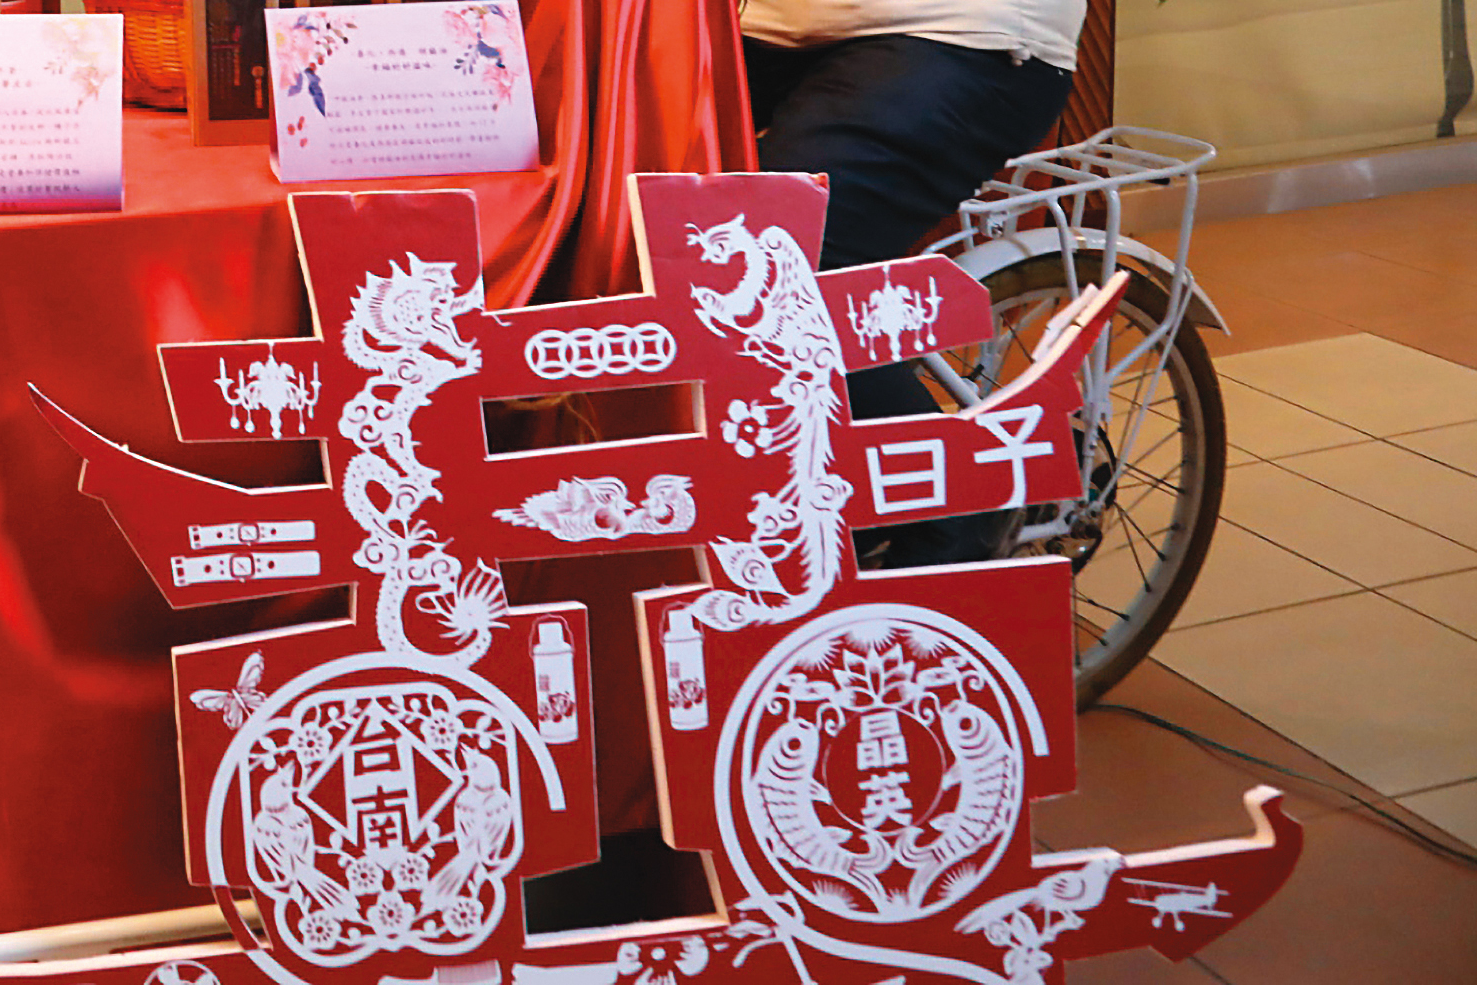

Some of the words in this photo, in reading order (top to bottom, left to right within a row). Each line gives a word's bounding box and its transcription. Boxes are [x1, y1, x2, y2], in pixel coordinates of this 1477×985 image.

[866, 404, 1053, 515] 日子
[350, 714, 410, 847] 台南
[855, 711, 913, 827] 晶英
